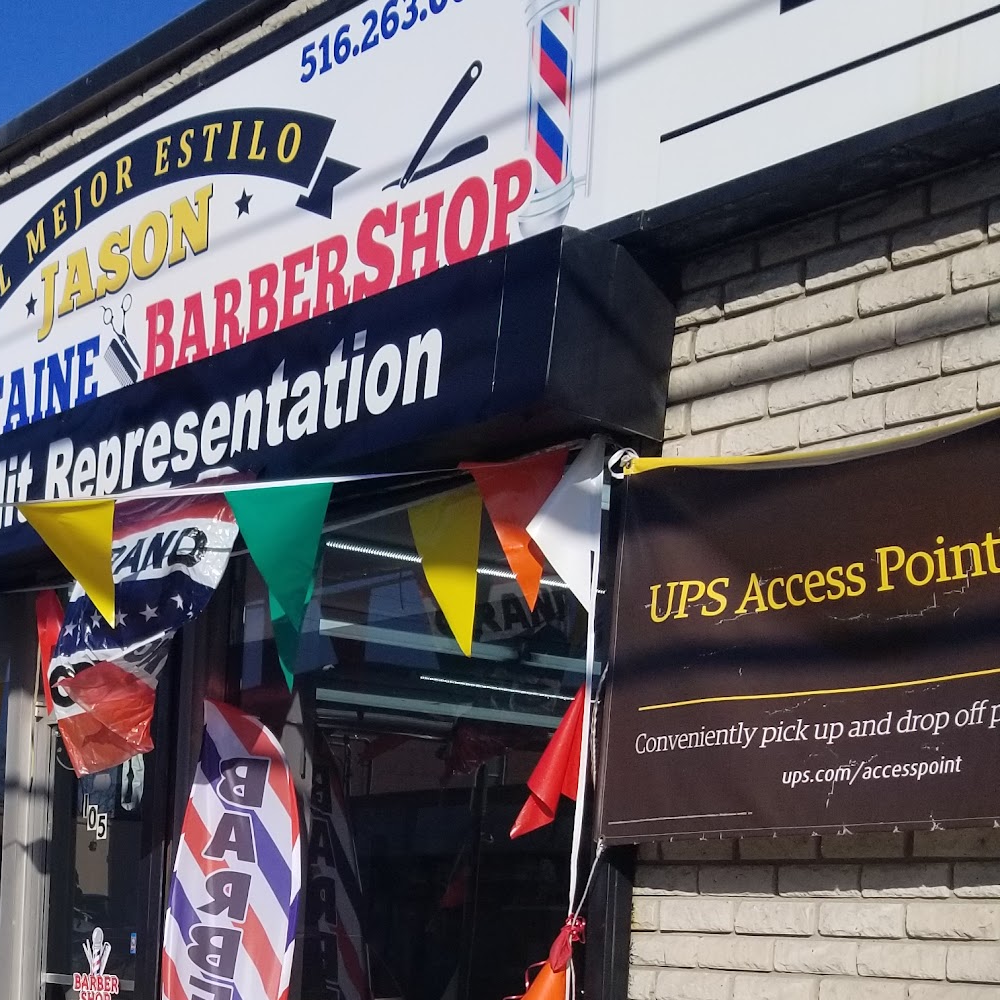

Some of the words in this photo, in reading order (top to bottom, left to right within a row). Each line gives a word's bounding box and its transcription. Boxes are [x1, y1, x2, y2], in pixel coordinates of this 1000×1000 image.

[300, 0, 463, 83] 516.263.
[25, 155, 133, 264] MEJOR
[154, 120, 302, 176] ESTILO
[37, 183, 214, 342] JASON
[44, 328, 444, 502] Representation
[649, 578, 729, 623] UPS
[735, 560, 867, 614] Access
[876, 532, 1000, 592] Point
[635, 720, 757, 754] Conveniently
[759, 718, 807, 748] pick
[814, 720, 845, 744] up
[847, 711, 893, 738] and
[896, 709, 950, 735] drop
[954, 699, 989, 727] off
[782, 755, 962, 785] ups.com/accesspoint
[84, 794, 106, 838] 105
[73, 973, 120, 994] BARBER
